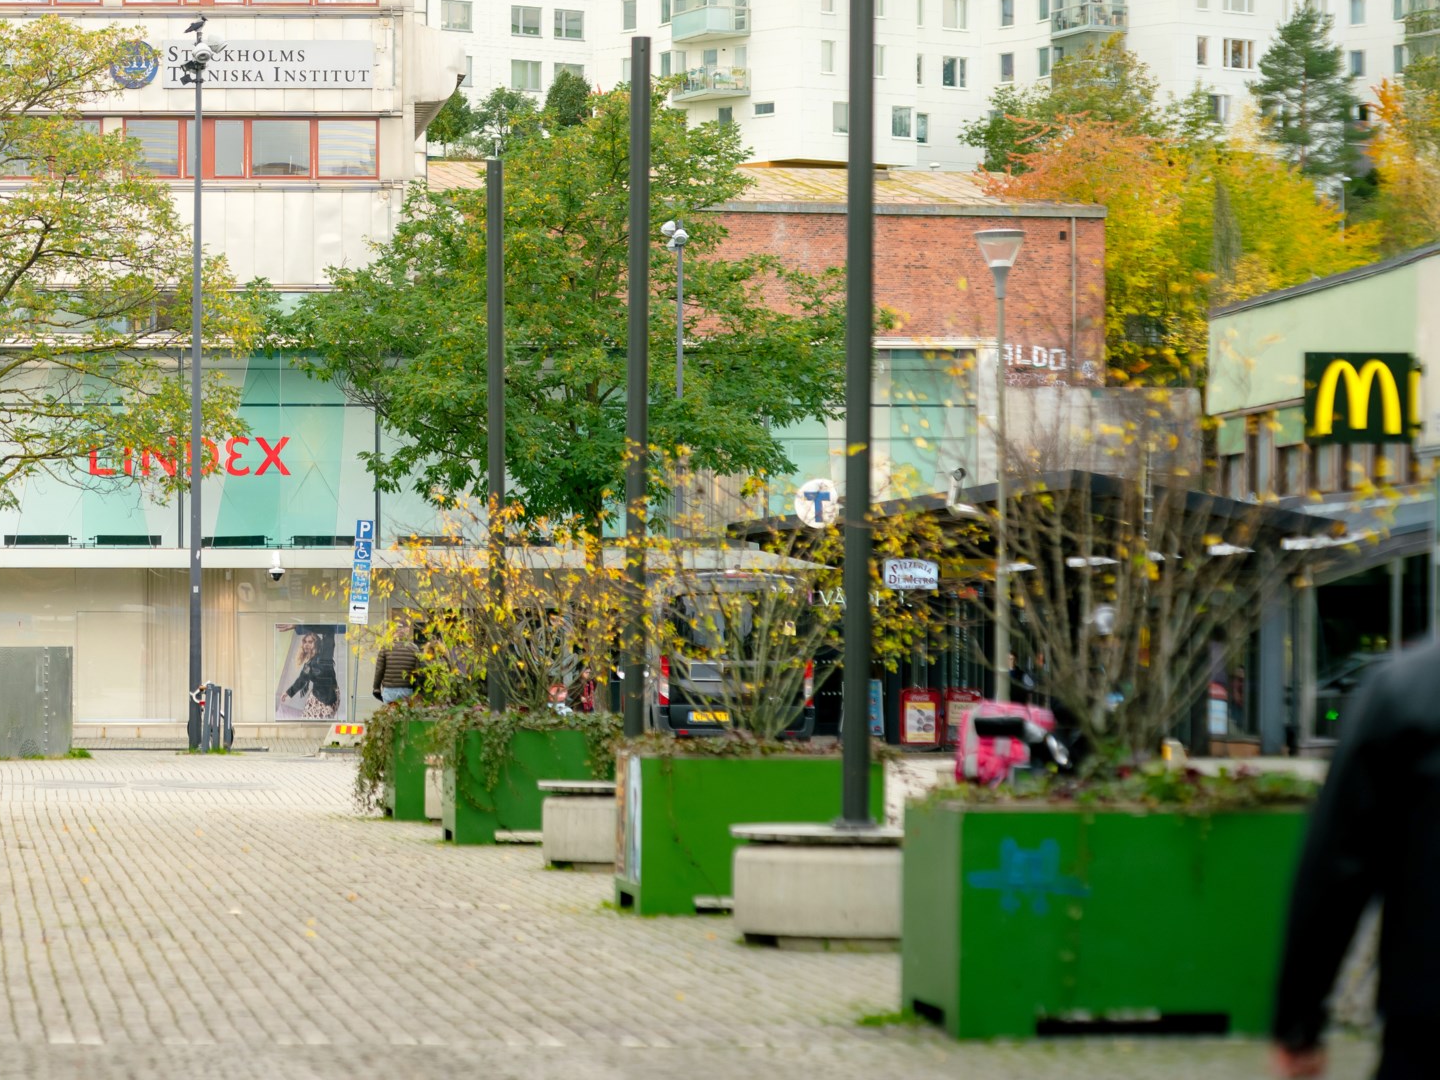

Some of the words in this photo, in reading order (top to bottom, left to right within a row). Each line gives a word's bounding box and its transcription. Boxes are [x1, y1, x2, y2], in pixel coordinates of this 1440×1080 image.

[167, 46, 306, 63] STCKHOLMS
[167, 66, 265, 82] TNISKA
[273, 66, 370, 82] INSTITUT
